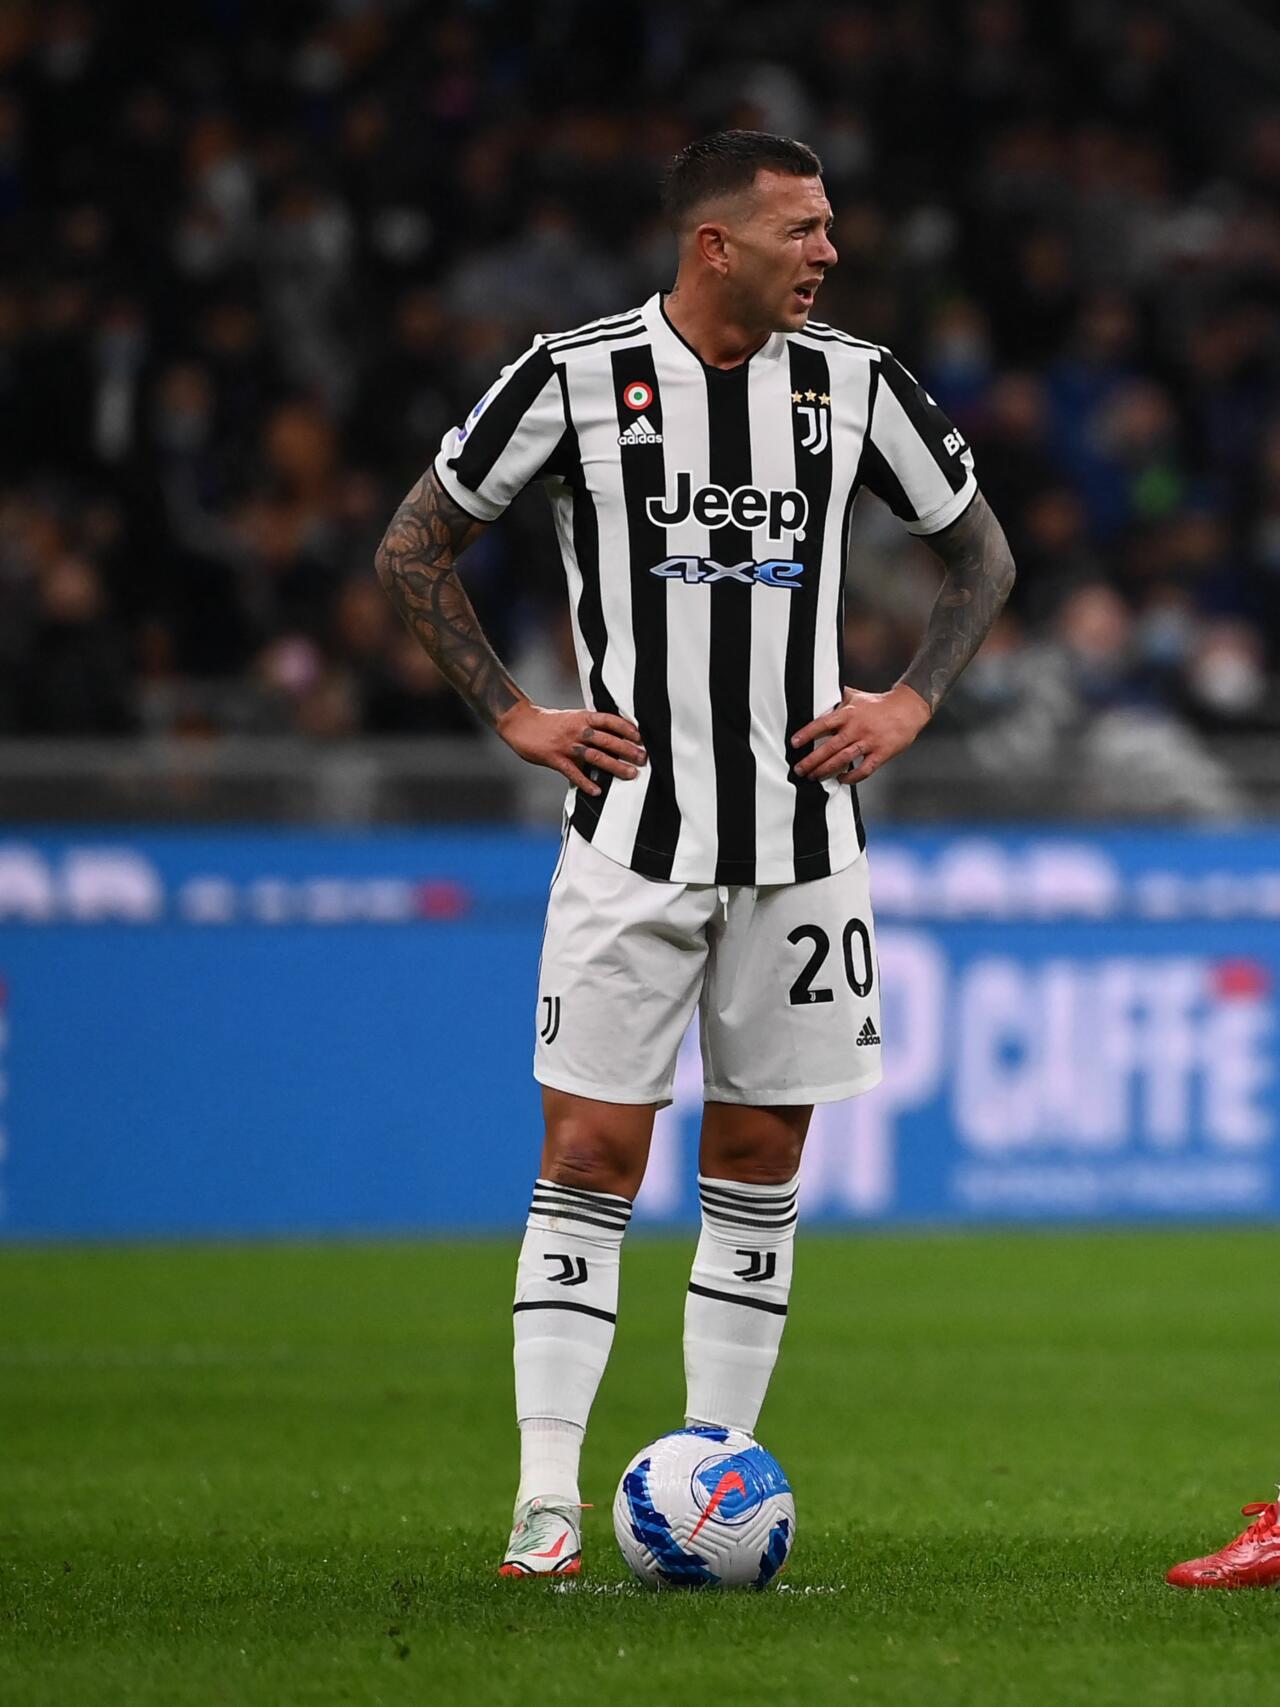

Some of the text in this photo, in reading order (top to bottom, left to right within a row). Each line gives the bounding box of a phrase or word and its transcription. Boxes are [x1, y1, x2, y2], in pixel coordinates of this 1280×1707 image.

[618, 433, 663, 446] adidas
[646, 470, 809, 543] Jeep
[786, 917, 874, 1006] 20
